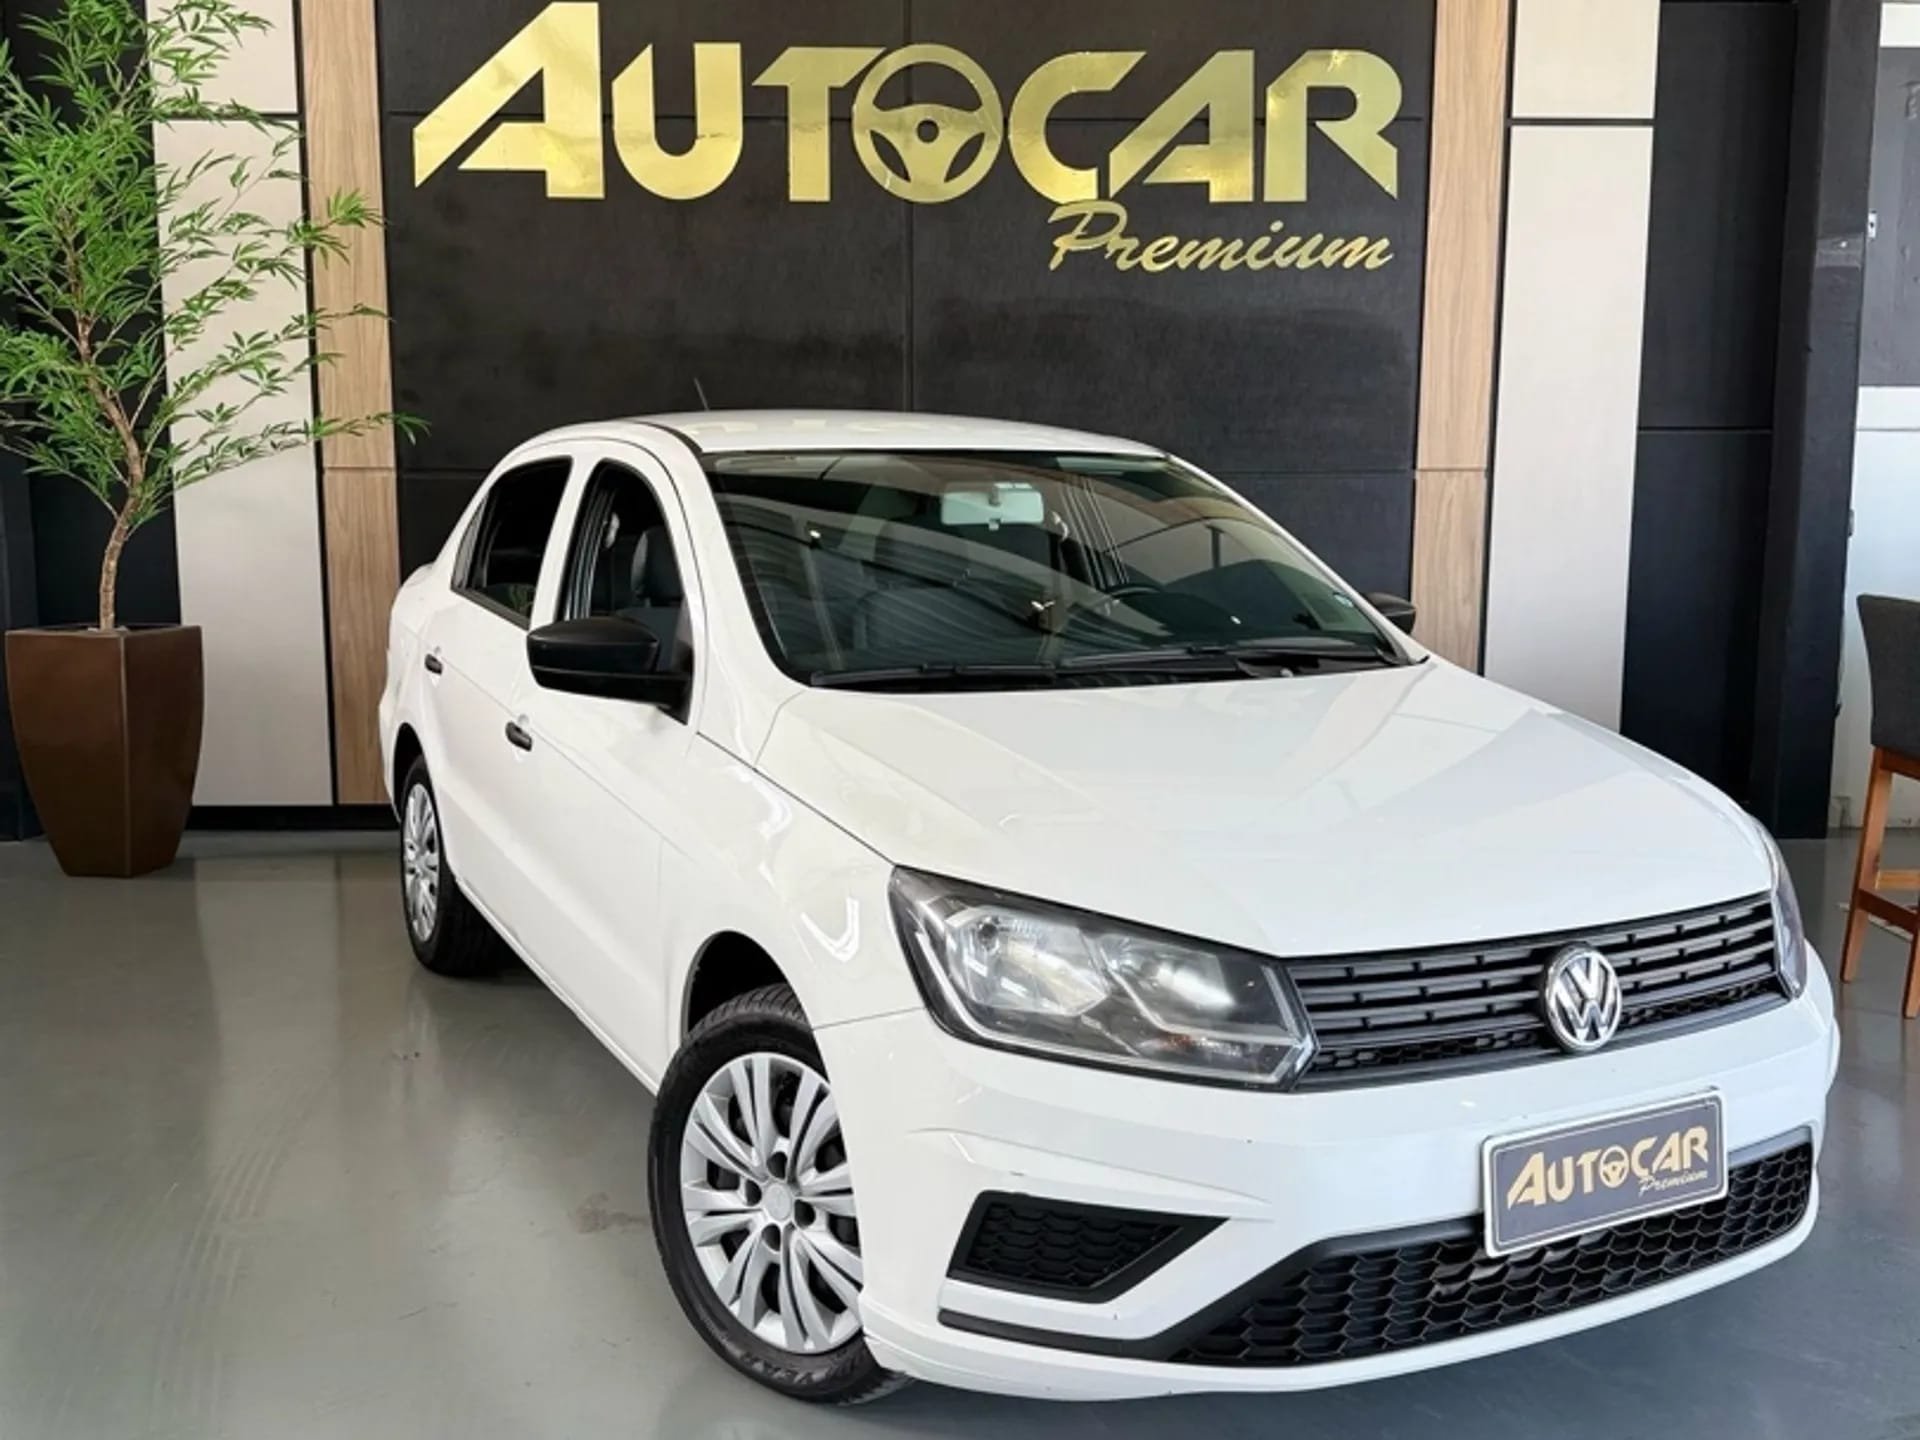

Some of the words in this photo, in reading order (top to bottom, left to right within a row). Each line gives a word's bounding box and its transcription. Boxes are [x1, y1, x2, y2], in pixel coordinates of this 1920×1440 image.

[413, 1, 1402, 203] AUTOCAR
[1048, 200, 1395, 272] Premium
[1507, 1126, 1709, 1210] AUTOCAR
